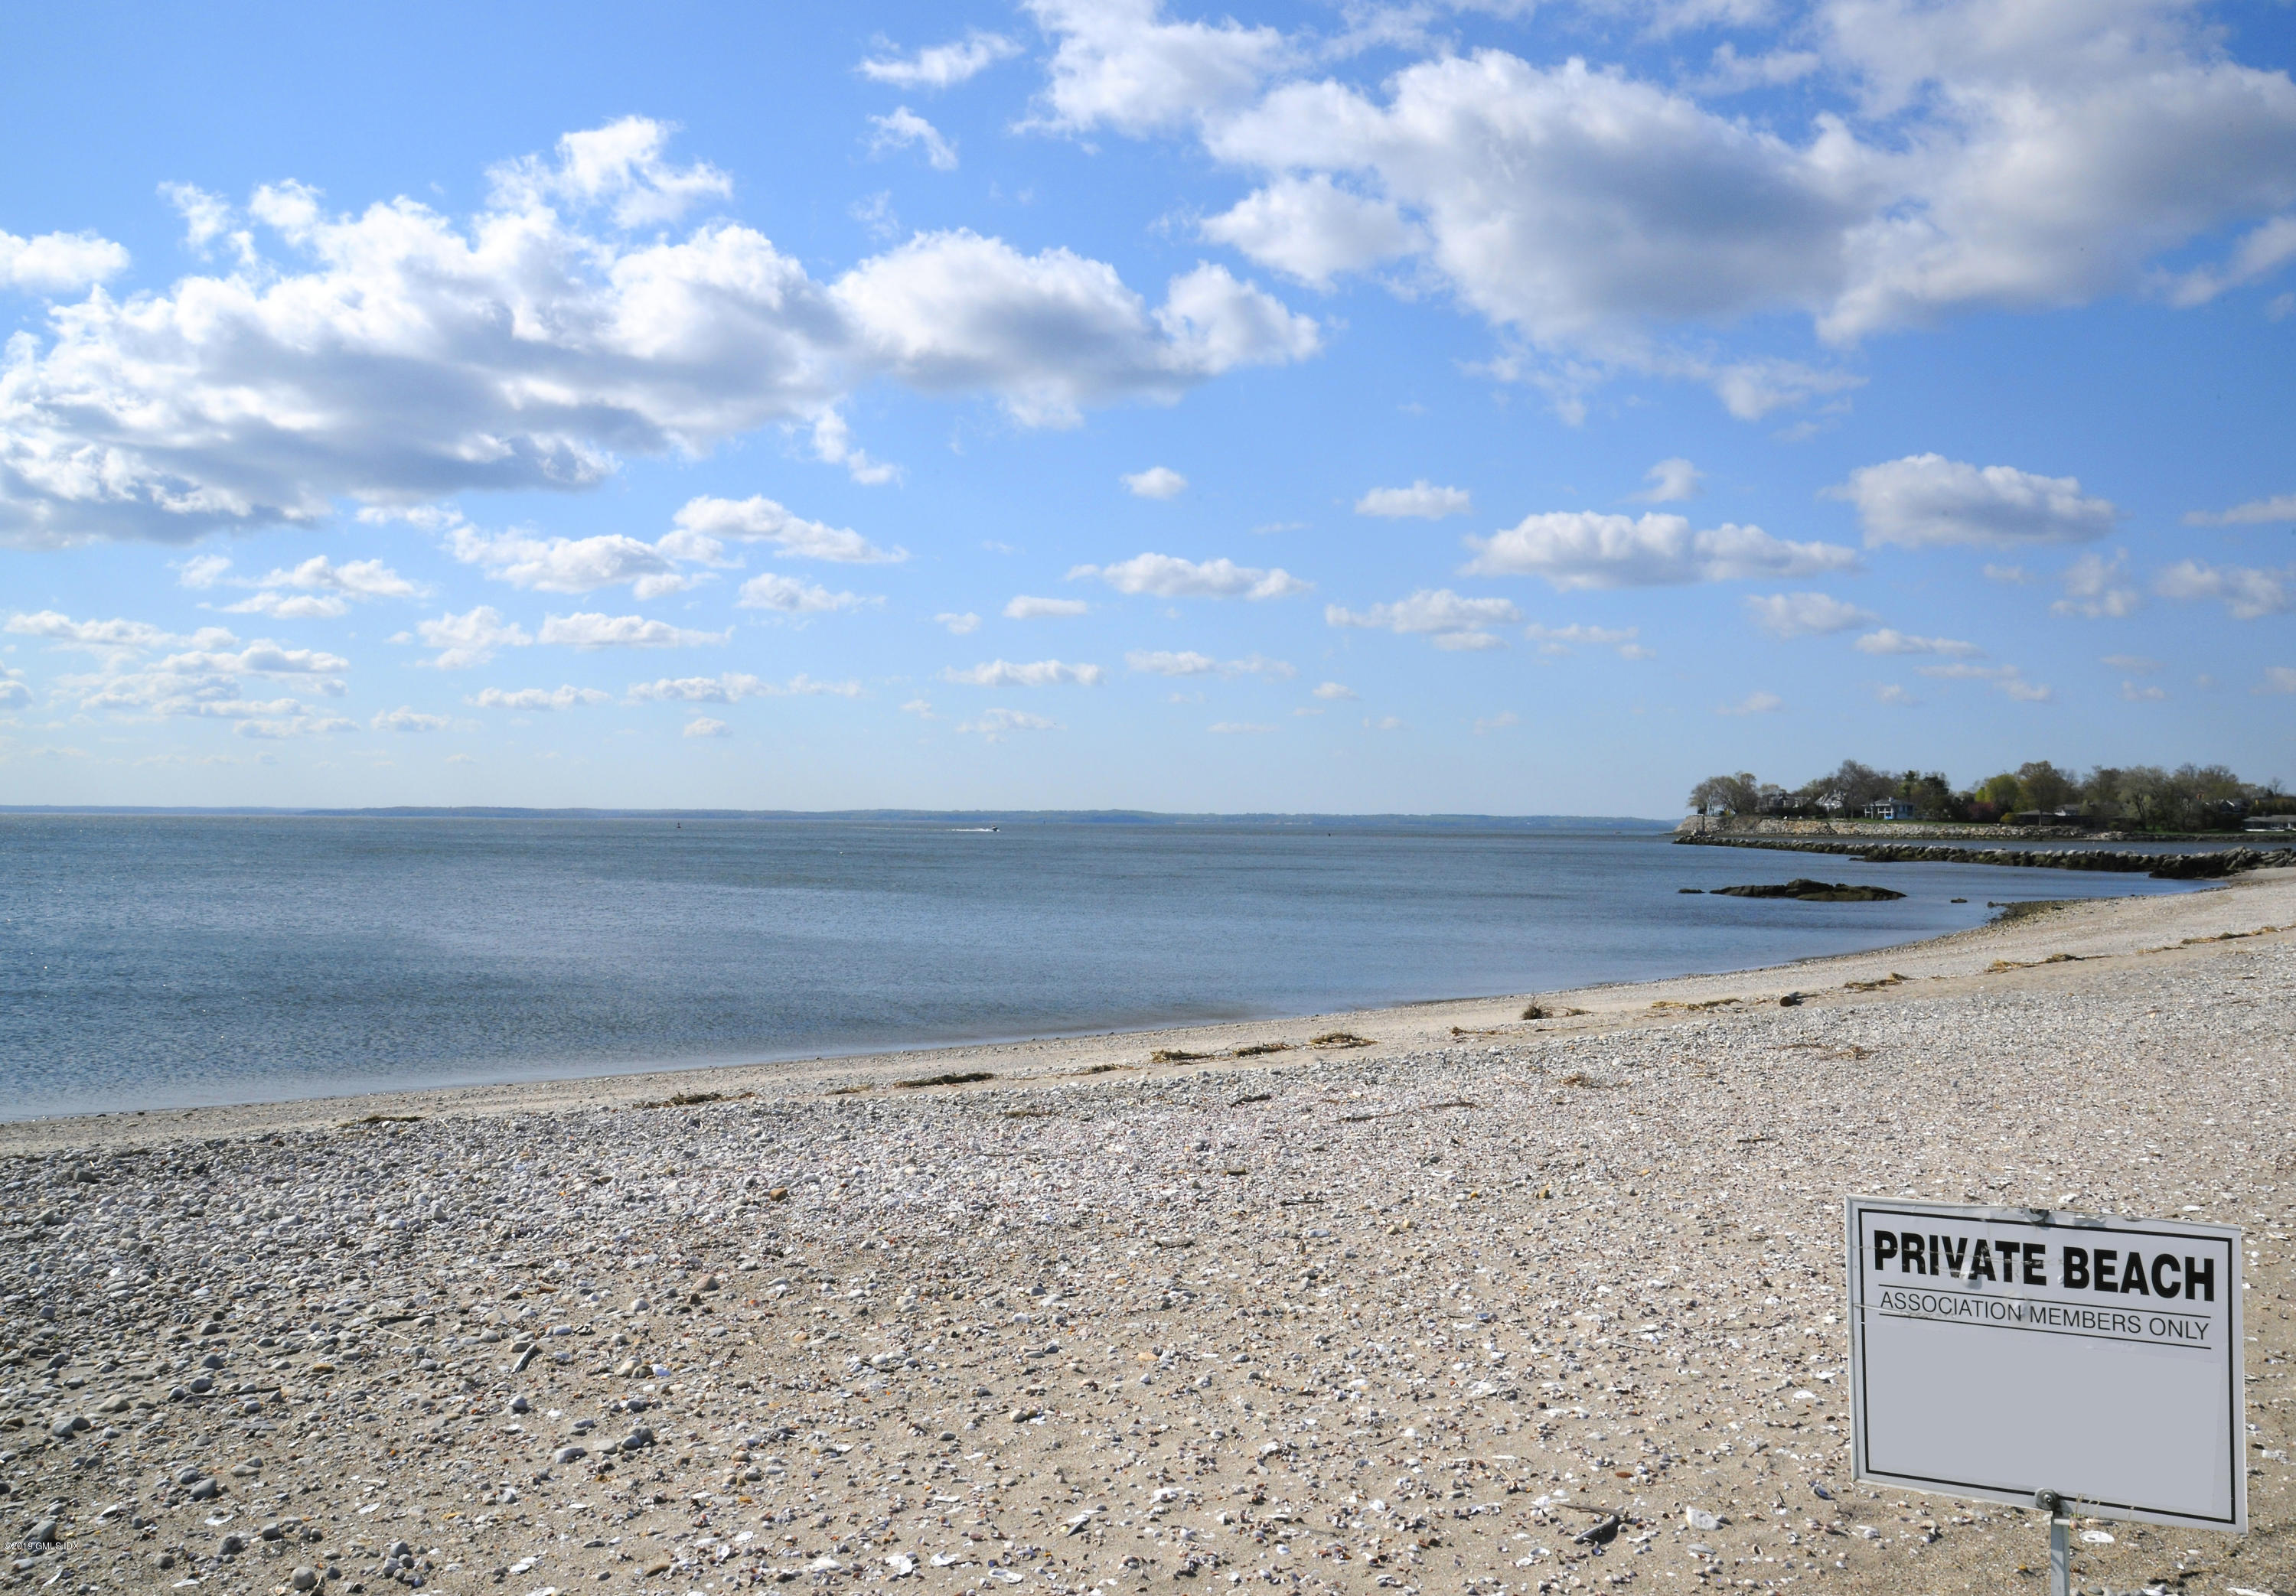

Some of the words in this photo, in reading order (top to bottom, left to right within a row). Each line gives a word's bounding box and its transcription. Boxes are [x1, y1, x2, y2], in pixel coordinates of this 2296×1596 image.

[1874, 1230, 2047, 1286] PRIVATE
[2063, 1246, 2215, 1301] BEACH
[1880, 1291, 2022, 1321] ASSOCIATION
[2030, 1306, 2141, 1334] MEMBERS
[2149, 1317, 2210, 1340] ONLY
